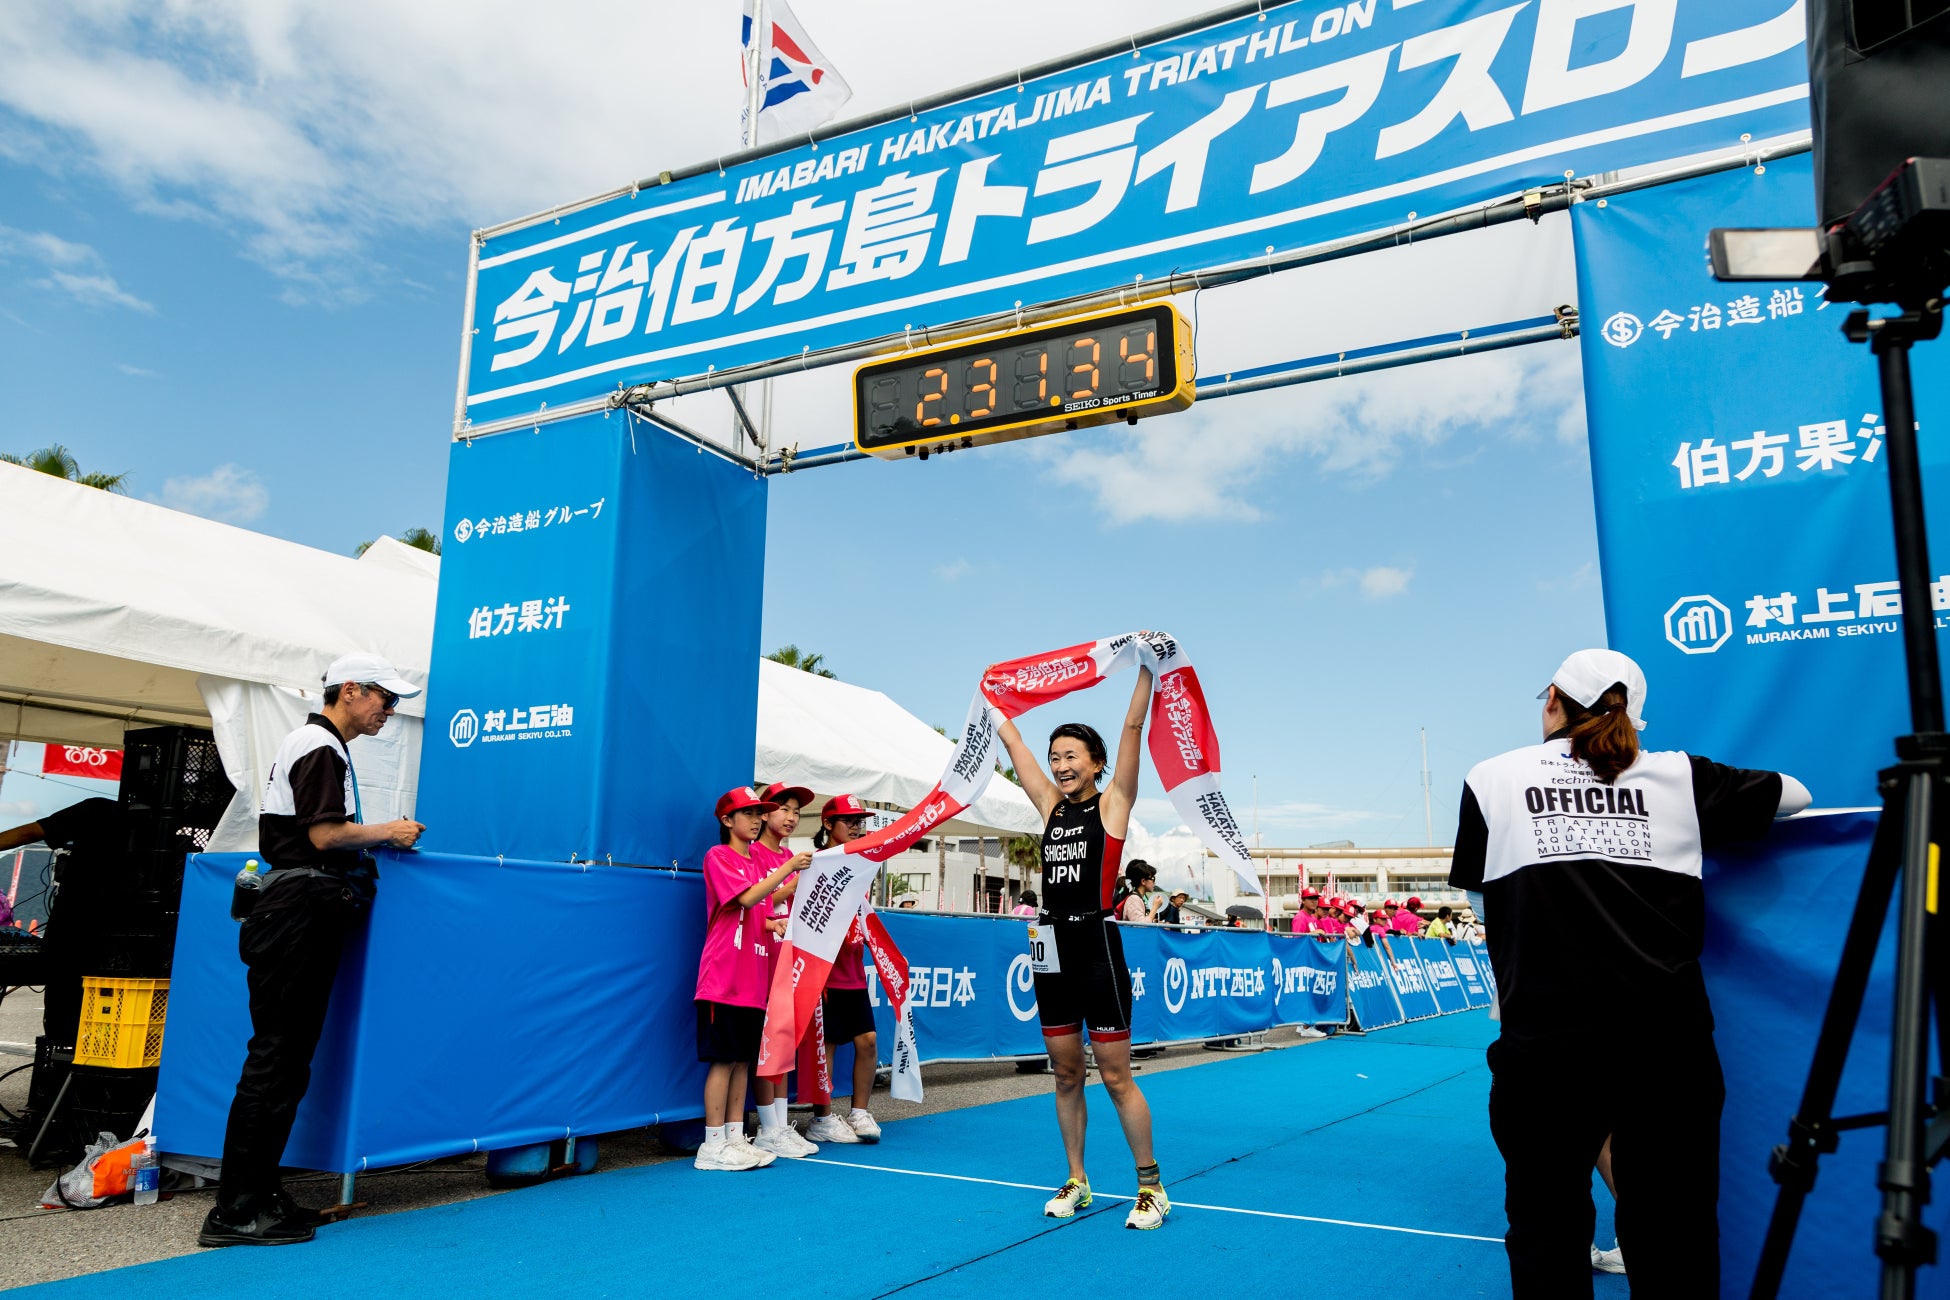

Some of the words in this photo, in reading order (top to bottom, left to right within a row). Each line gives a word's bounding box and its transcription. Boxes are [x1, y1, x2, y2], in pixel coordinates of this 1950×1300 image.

[735, 143, 872, 204] IMABARI
[878, 76, 1112, 166] HAKATAJIMA
[1123, 0, 1377, 97] TRIATHLON
[1064, 398, 1101, 413] SEIKO
[1102, 393, 1131, 406] Sports
[1132, 390, 1158, 400] Timer
[474, 497, 605, 539] 今治造船グループ
[468, 596, 571, 639] 伯方果汁
[1746, 627, 1830, 645] MURAKAMI
[1836, 621, 1898, 637] SEKIYU
[1016, 661, 1089, 692] トライアスロン
[483, 703, 574, 732] 村上石油
[482, 733, 516, 743] MURAKAMI
[518, 731, 542, 740] SEKIYU
[1525, 786, 1650, 817] OFFICIAL
[1063, 825, 1085, 838] NTT
[1533, 818, 1650, 831] TRIATHLON
[1534, 825, 1651, 839] DUATHLON
[1044, 840, 1088, 863] SHIGENARI
[1537, 834, 1652, 849] AQUATHLON
[1537, 842, 1652, 857] MULTISPORT
[1047, 863, 1081, 884] JPN
[799, 872, 829, 923] IMABARI
[806, 865, 852, 930] HAKATAJIMA
[1191, 966, 1265, 999] NTT西日本
[1284, 966, 1337, 995] NTT西日本
